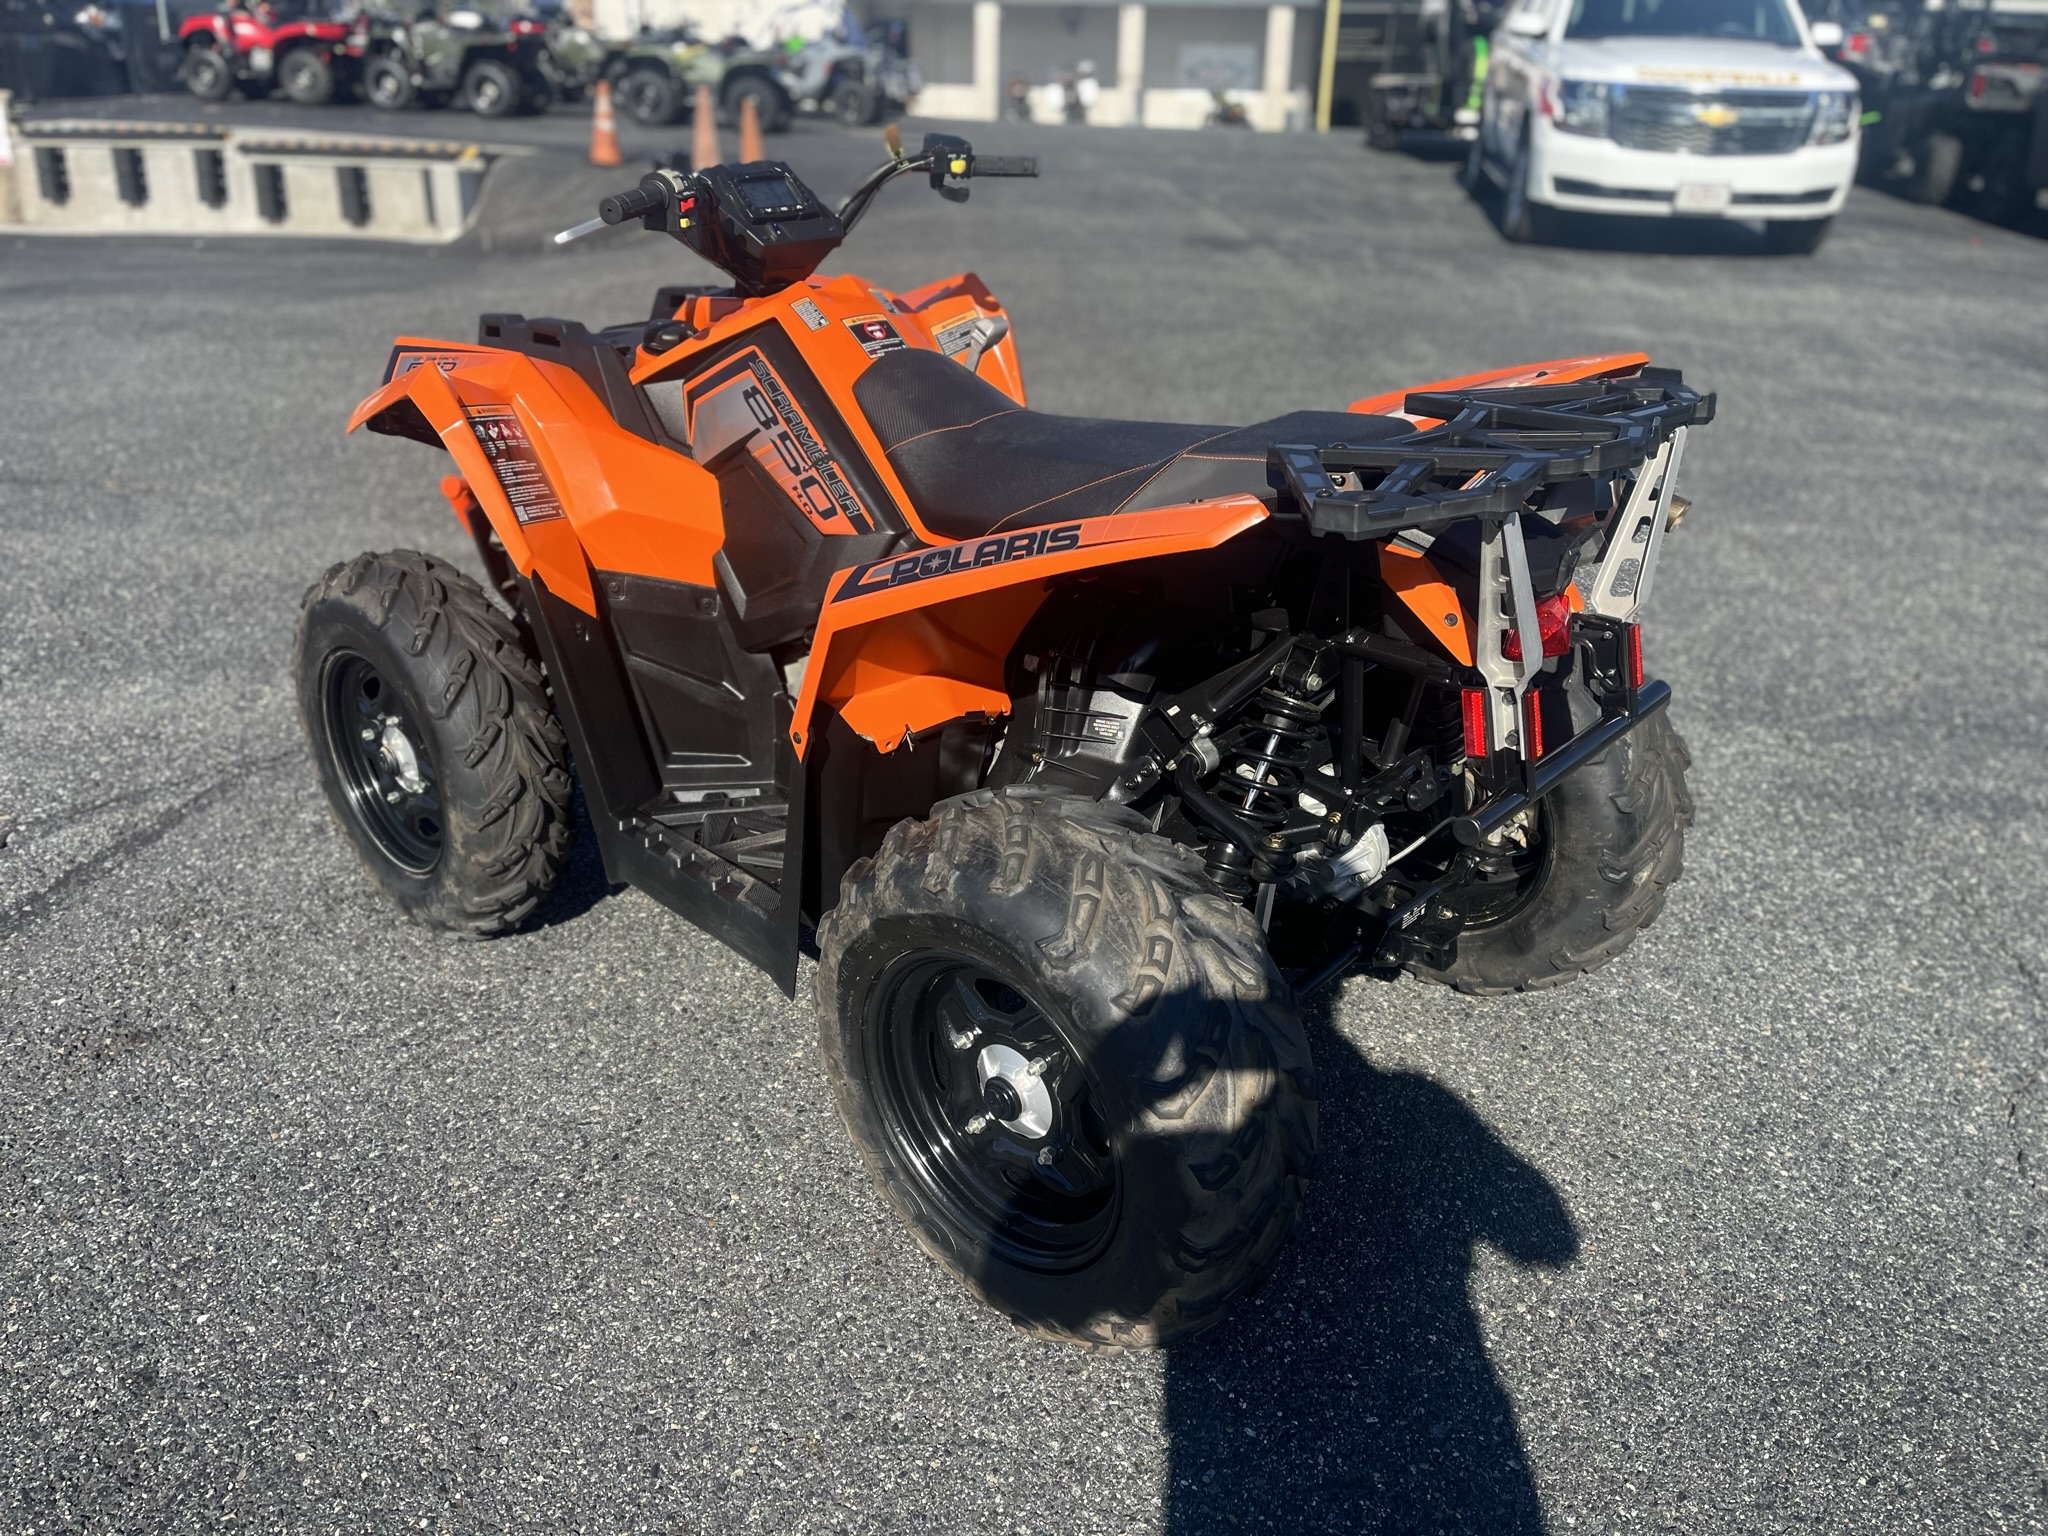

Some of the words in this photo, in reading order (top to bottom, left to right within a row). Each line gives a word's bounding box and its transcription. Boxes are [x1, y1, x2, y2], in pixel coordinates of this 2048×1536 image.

[742, 385, 839, 522] 850
[748, 358, 862, 517] SCRAMBLER
[888, 523, 1083, 586] POLARIS
